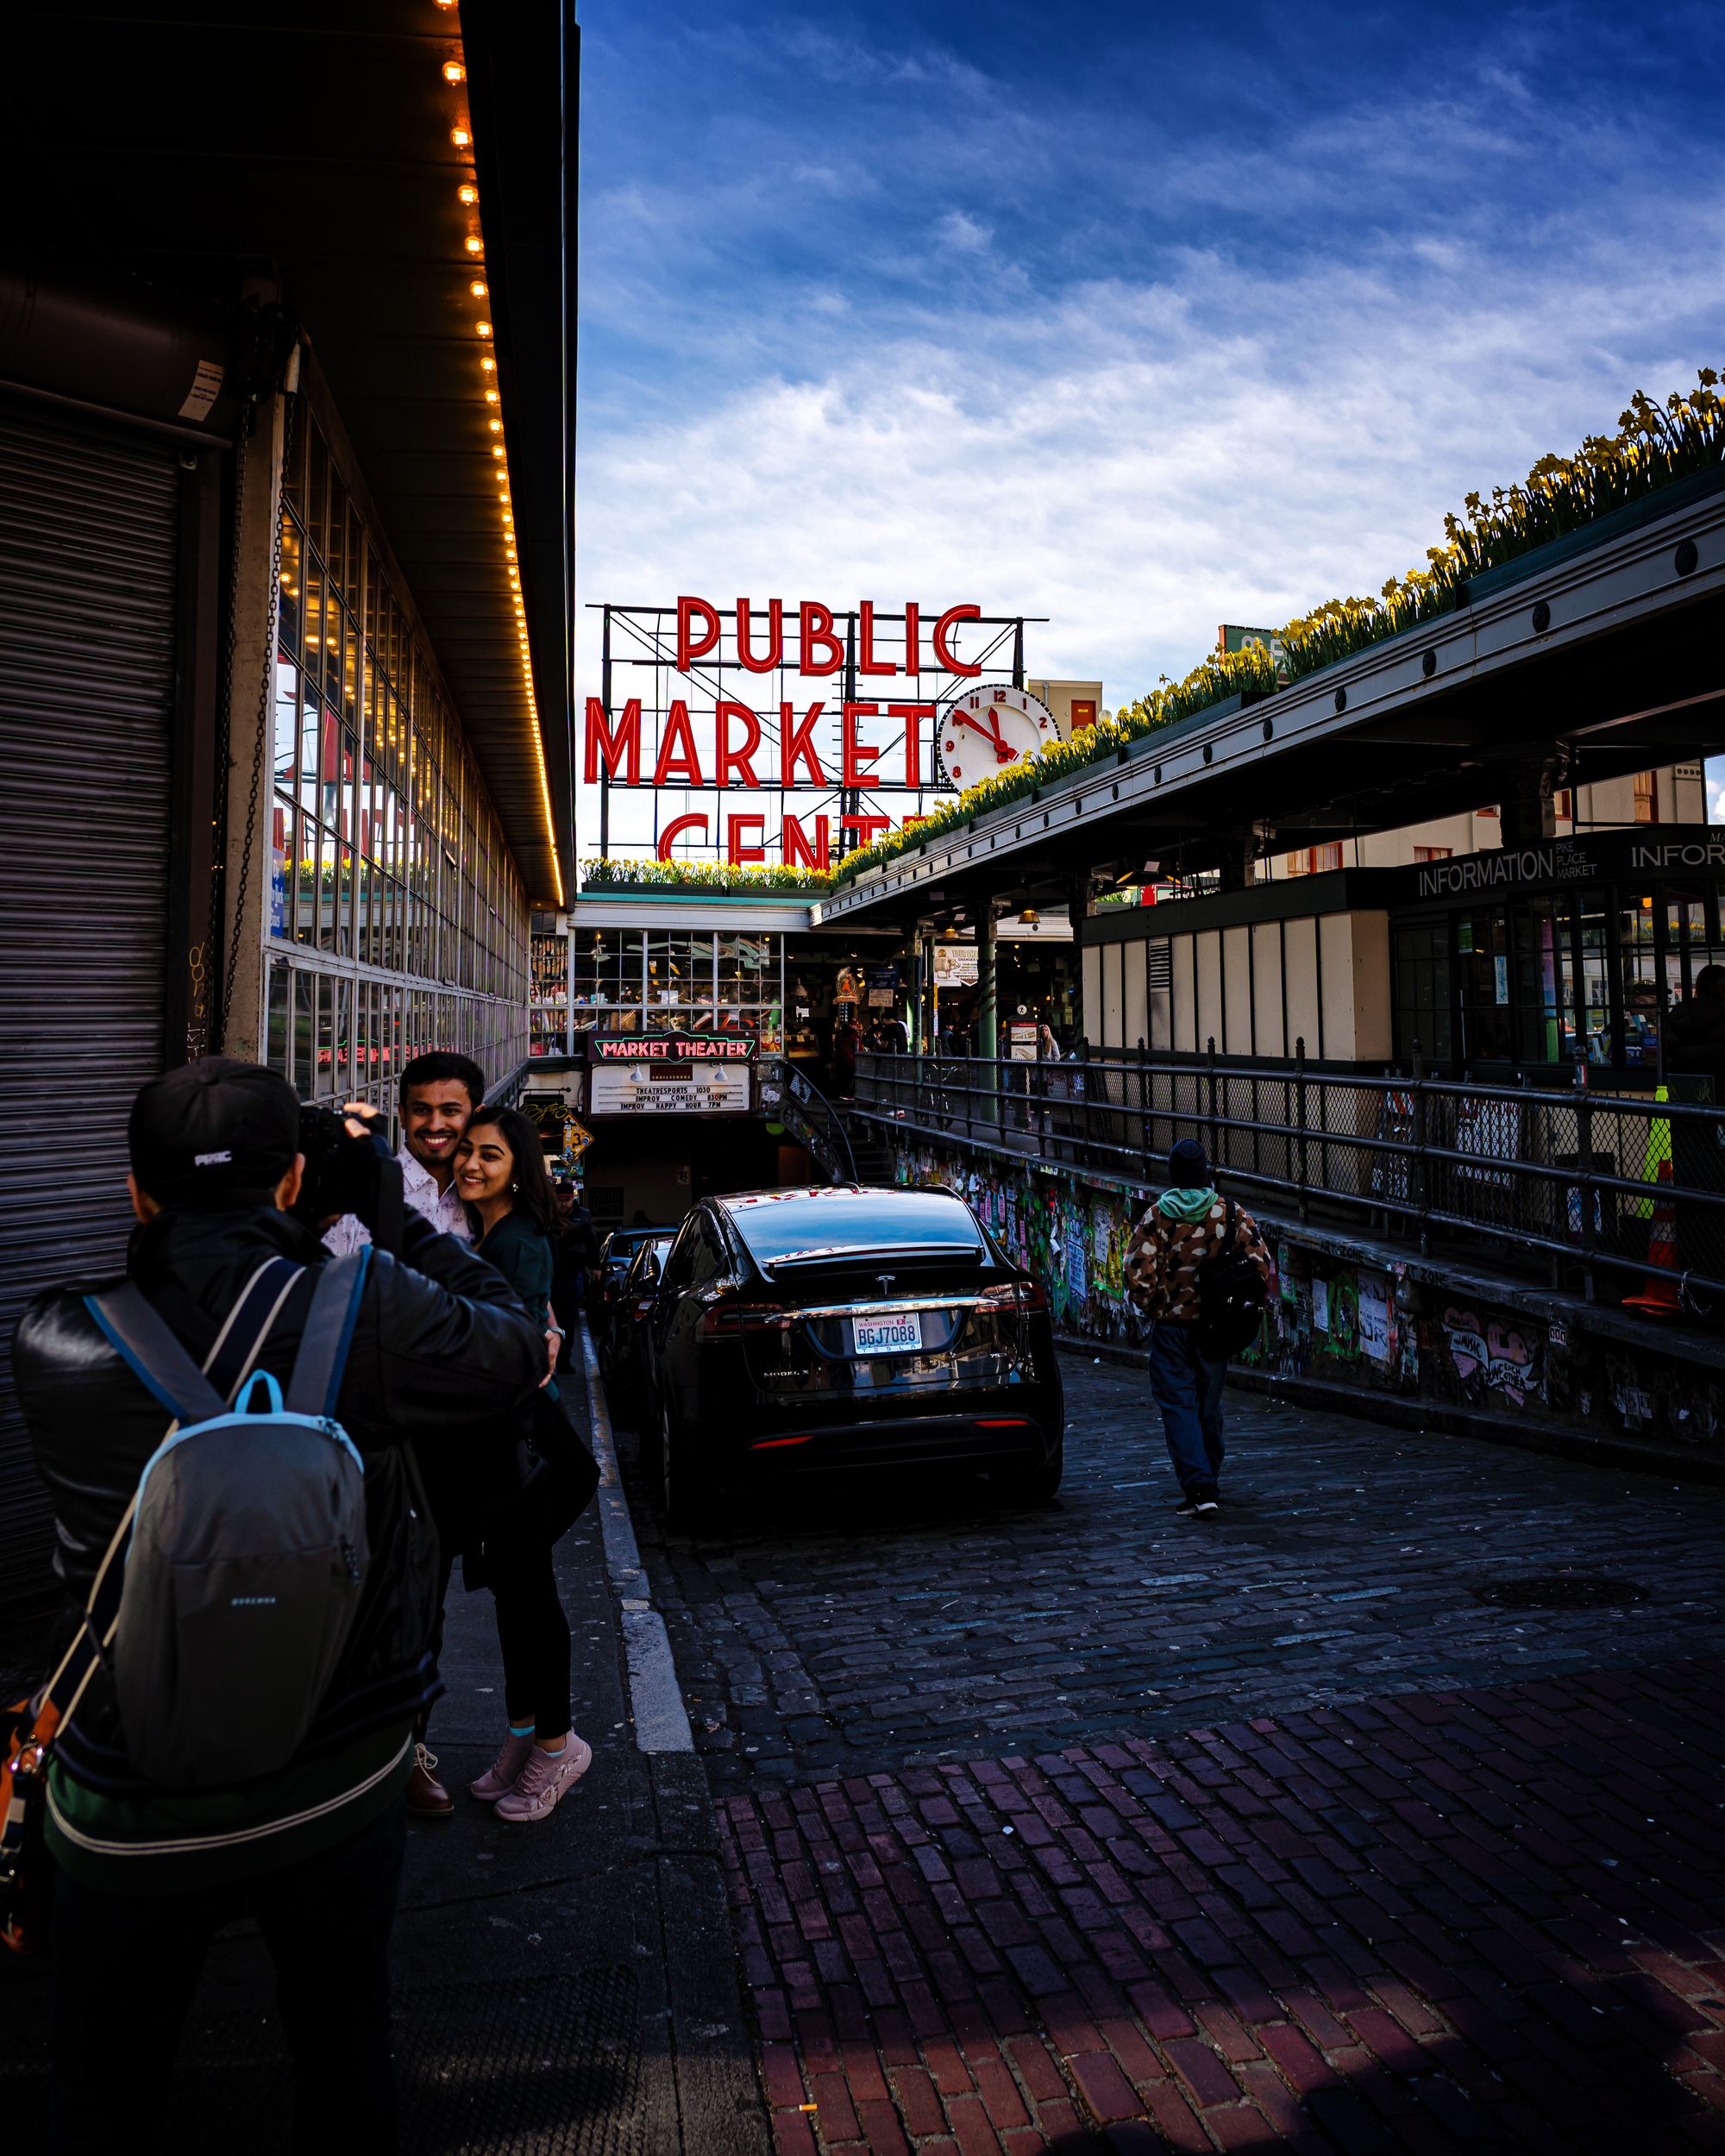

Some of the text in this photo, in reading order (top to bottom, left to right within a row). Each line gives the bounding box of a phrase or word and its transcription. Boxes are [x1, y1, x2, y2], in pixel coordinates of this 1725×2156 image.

[677, 596, 982, 677] PUBLIC
[970, 697, 980, 709] 11
[994, 690, 1007, 703] 12
[1039, 717, 1048, 729] 2
[584, 697, 936, 788] MARKET
[945, 740, 955, 752] 9
[952, 766, 962, 778] 8
[658, 812, 925, 873] CENT
[1556, 842, 1574, 854] PIKE
[1556, 854, 1586, 867] PLACE
[1630, 843, 1725, 868] INFOR
[1419, 849, 1554, 897] INFORMATION
[1557, 864, 1596, 880] MARKET
[603, 1041, 747, 1057] MARKET THEATER
[1339, 1243, 1364, 1263] ZONE
[1421, 1264, 1449, 1286] ZONE
[858, 1326, 916, 1345] BGJ7088
